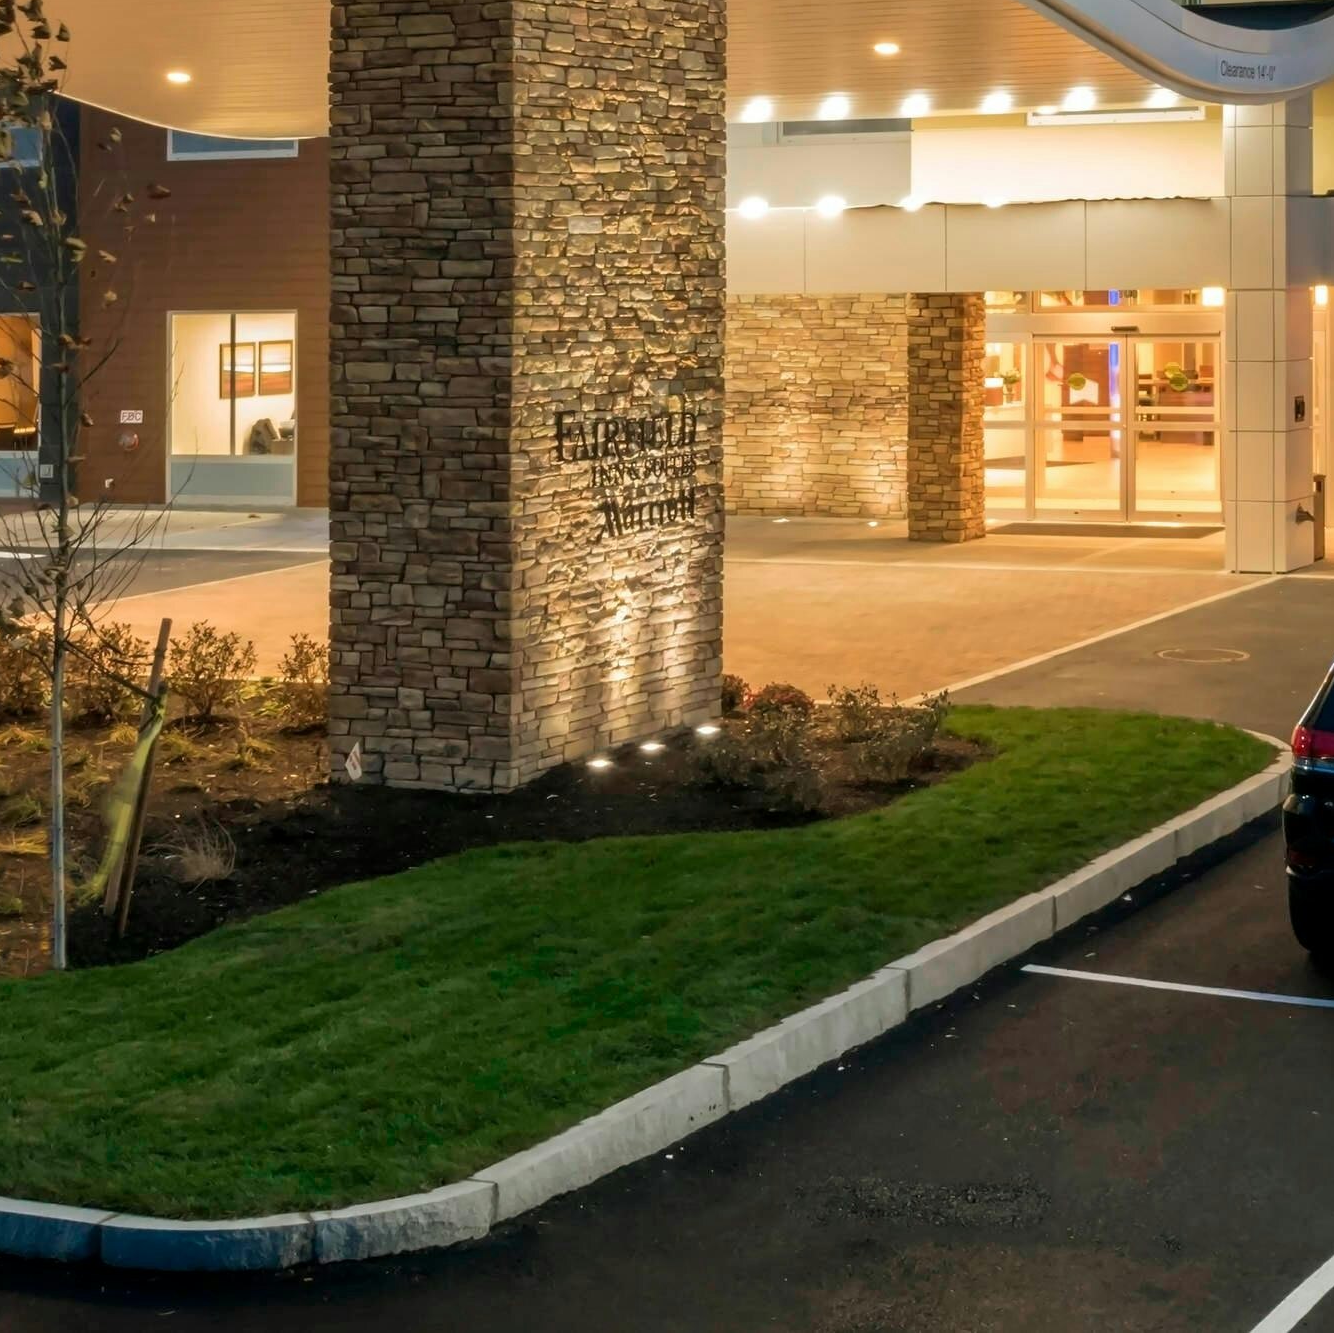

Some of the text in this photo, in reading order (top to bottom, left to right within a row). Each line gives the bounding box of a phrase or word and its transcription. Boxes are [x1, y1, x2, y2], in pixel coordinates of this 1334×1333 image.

[1220, 60, 1255, 80] Clearance
[555, 410, 697, 462] FAIRFIELD
[589, 486, 697, 544] Marriott
